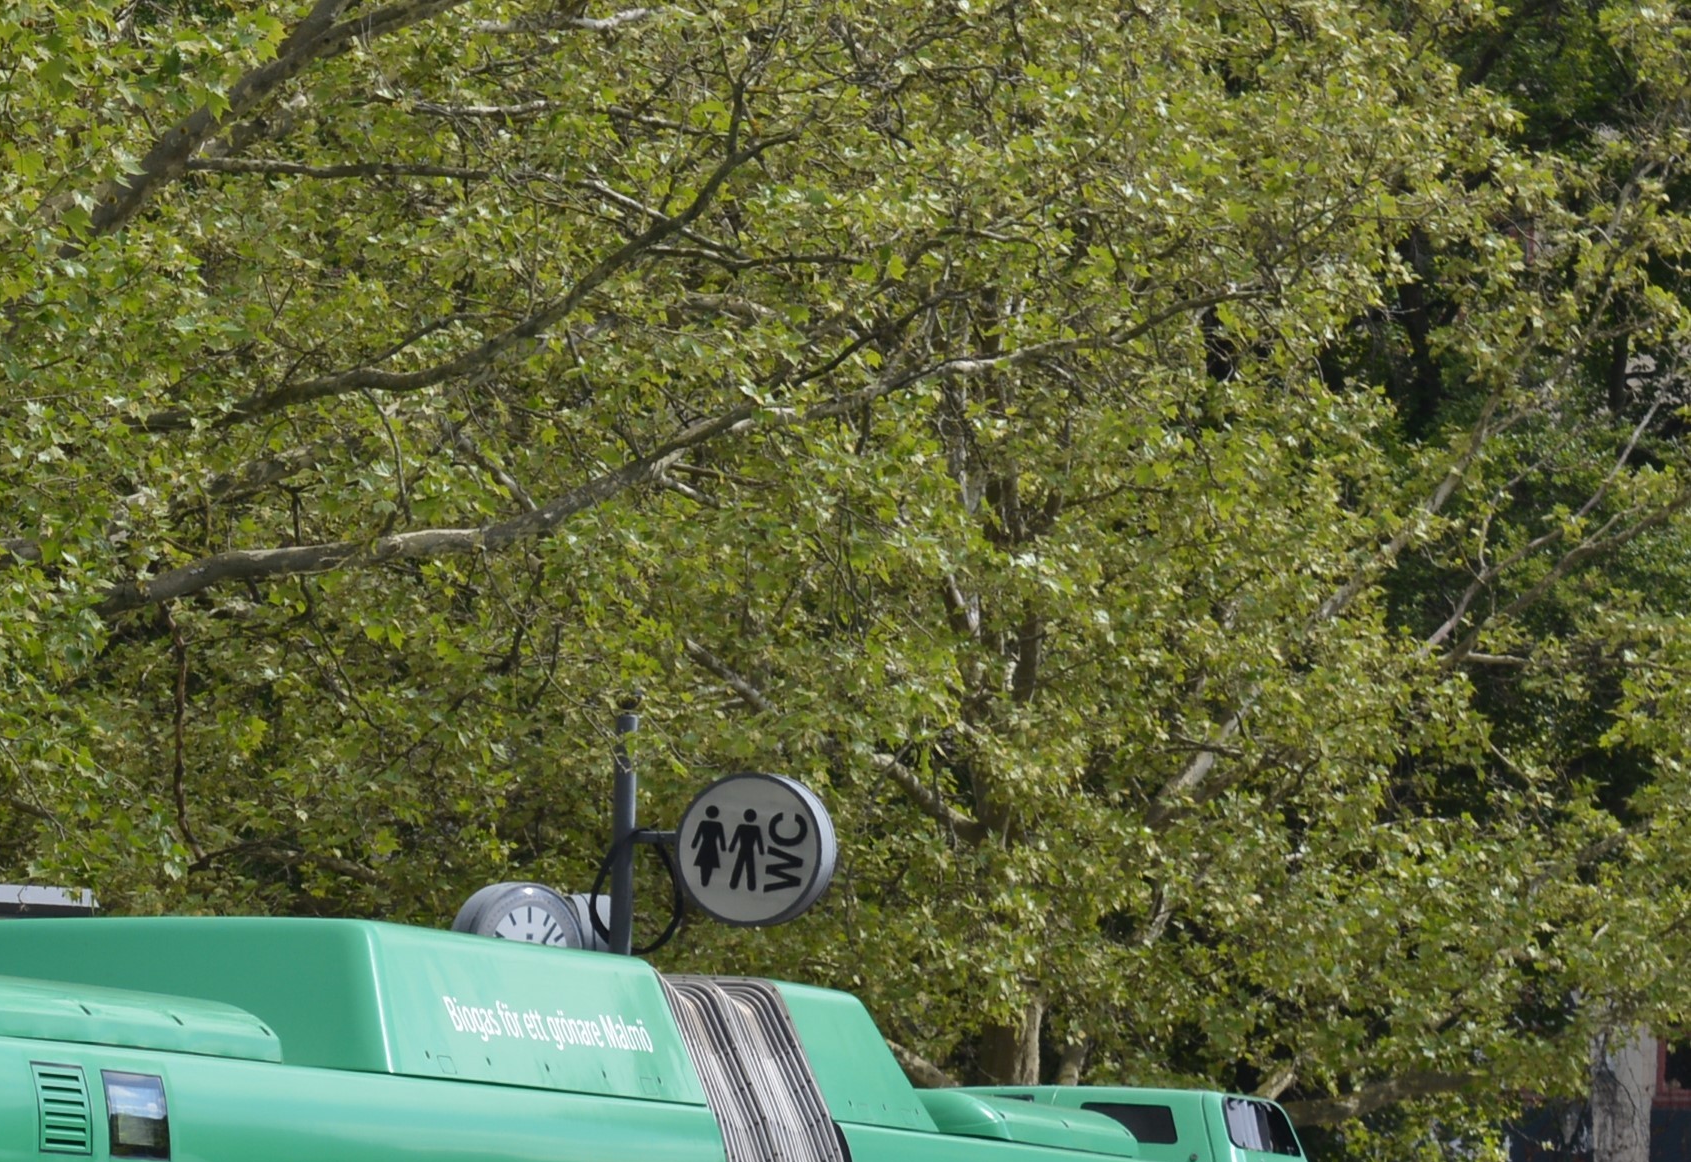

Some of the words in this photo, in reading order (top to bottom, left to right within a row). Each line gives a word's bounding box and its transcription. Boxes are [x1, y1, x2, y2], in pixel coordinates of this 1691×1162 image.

[763, 812, 808, 893] WC
[443, 996, 502, 1042] Biogas
[496, 1000, 525, 1038] för
[522, 1009, 550, 1042] ett
[546, 1009, 605, 1051] grönare
[598, 1014, 654, 1053] Malmö
